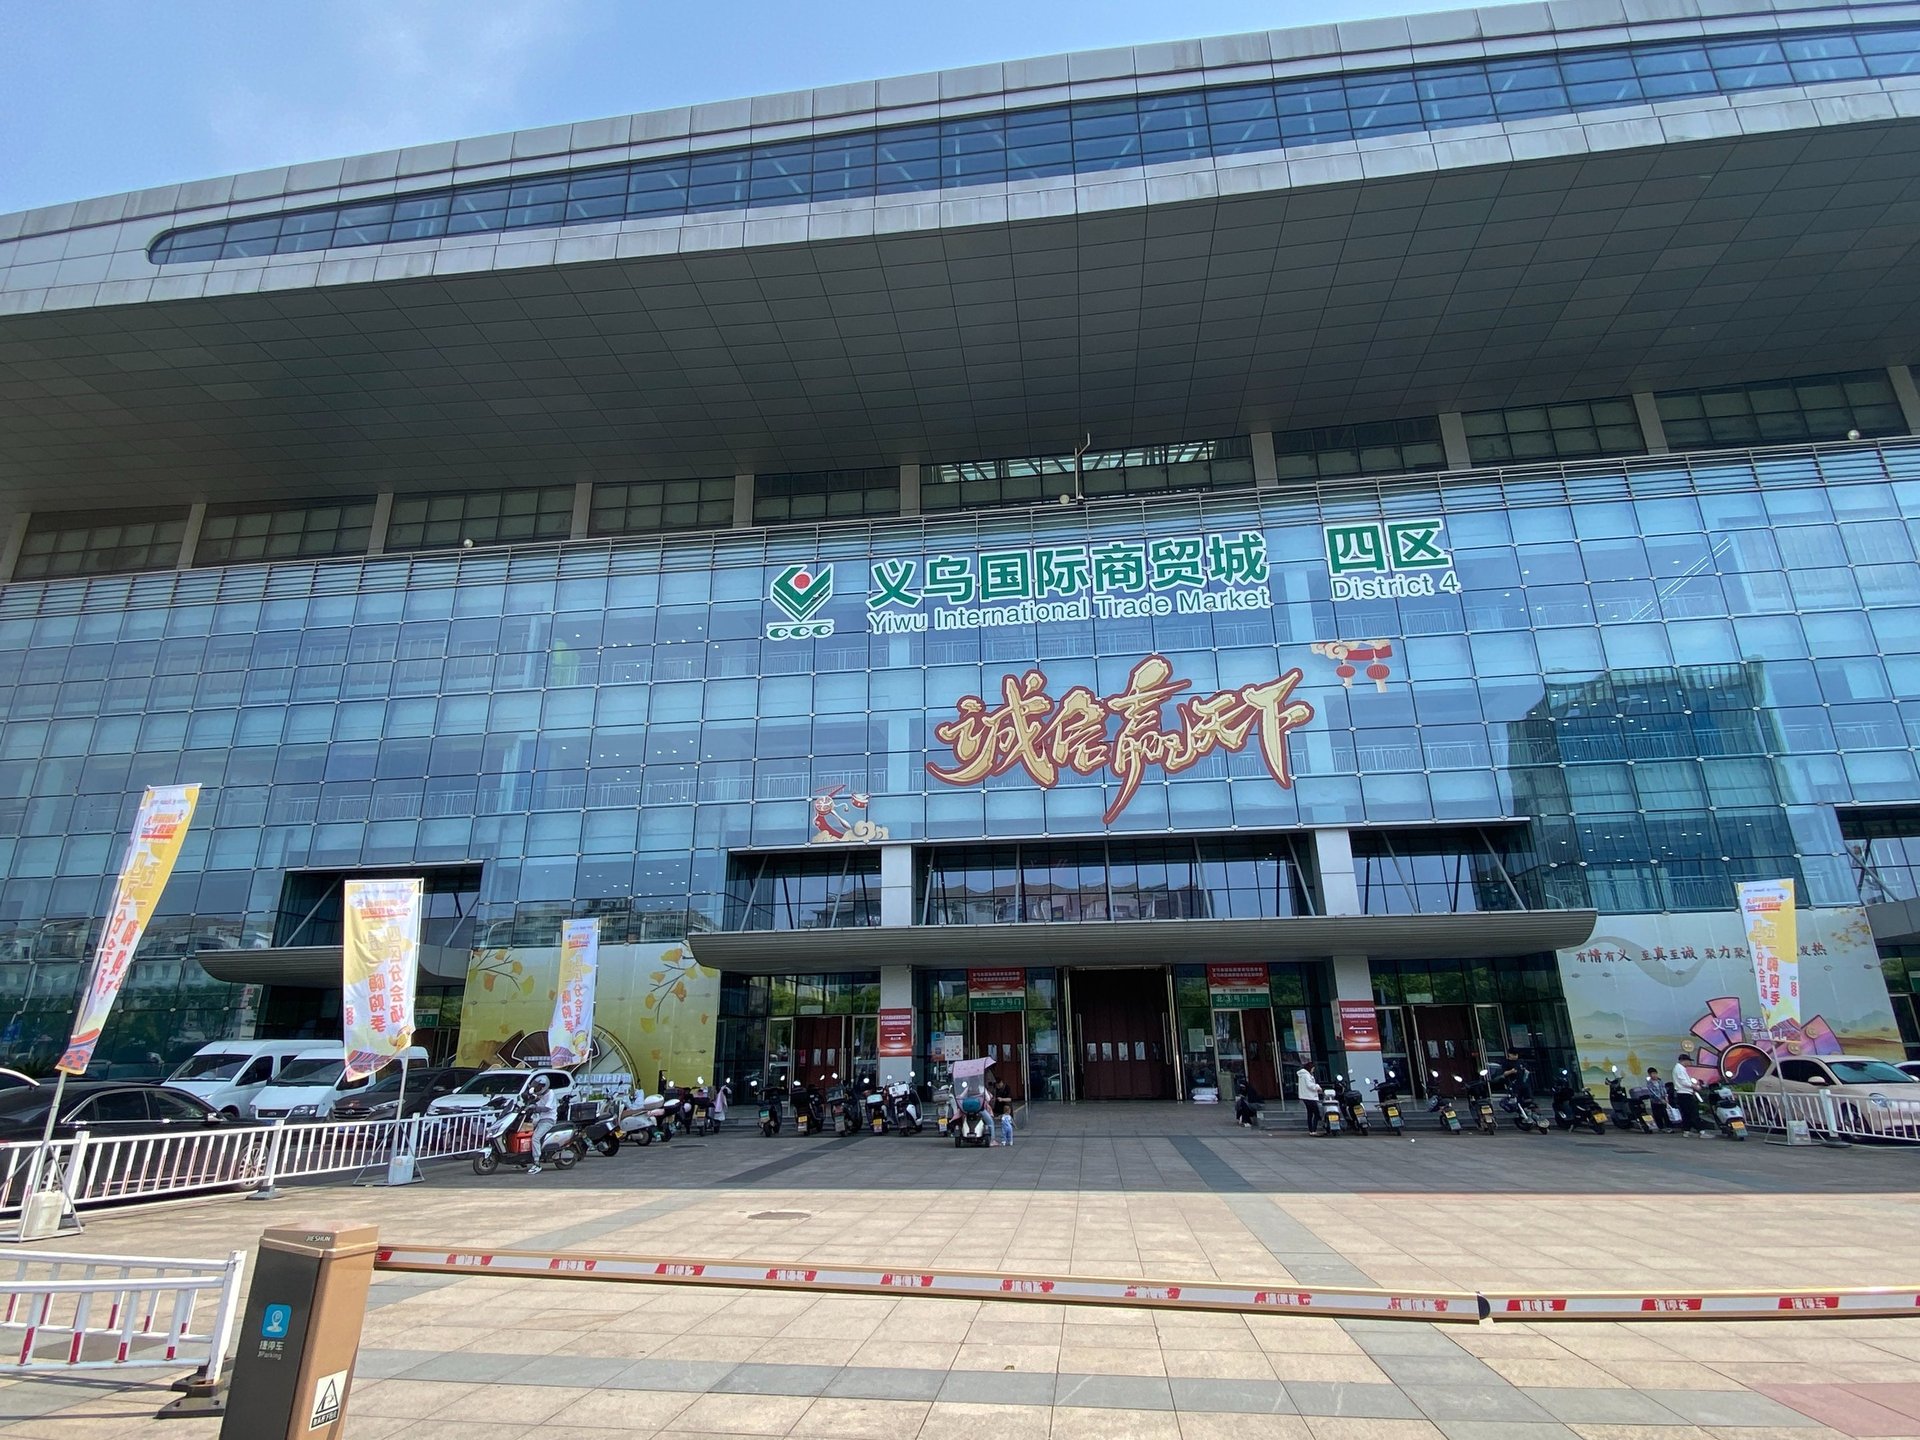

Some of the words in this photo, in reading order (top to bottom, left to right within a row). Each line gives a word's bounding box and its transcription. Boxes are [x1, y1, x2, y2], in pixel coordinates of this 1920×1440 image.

[1325, 520, 1450, 573] 四区
[868, 533, 1268, 609] 义乌国际商贸城
[1332, 576, 1432, 599] District
[1440, 574, 1459, 593] 4
[869, 612, 927, 633] Yiwu
[937, 599, 1088, 630] International
[1097, 595, 1169, 617] Trade
[1180, 589, 1269, 612] Market
[927, 654, 1313, 824] 诚信赢天下
[1575, 948, 1632, 963] 有情有义
[1641, 945, 1698, 961] 至真至诚
[1704, 945, 1750, 959] 聚力聚
